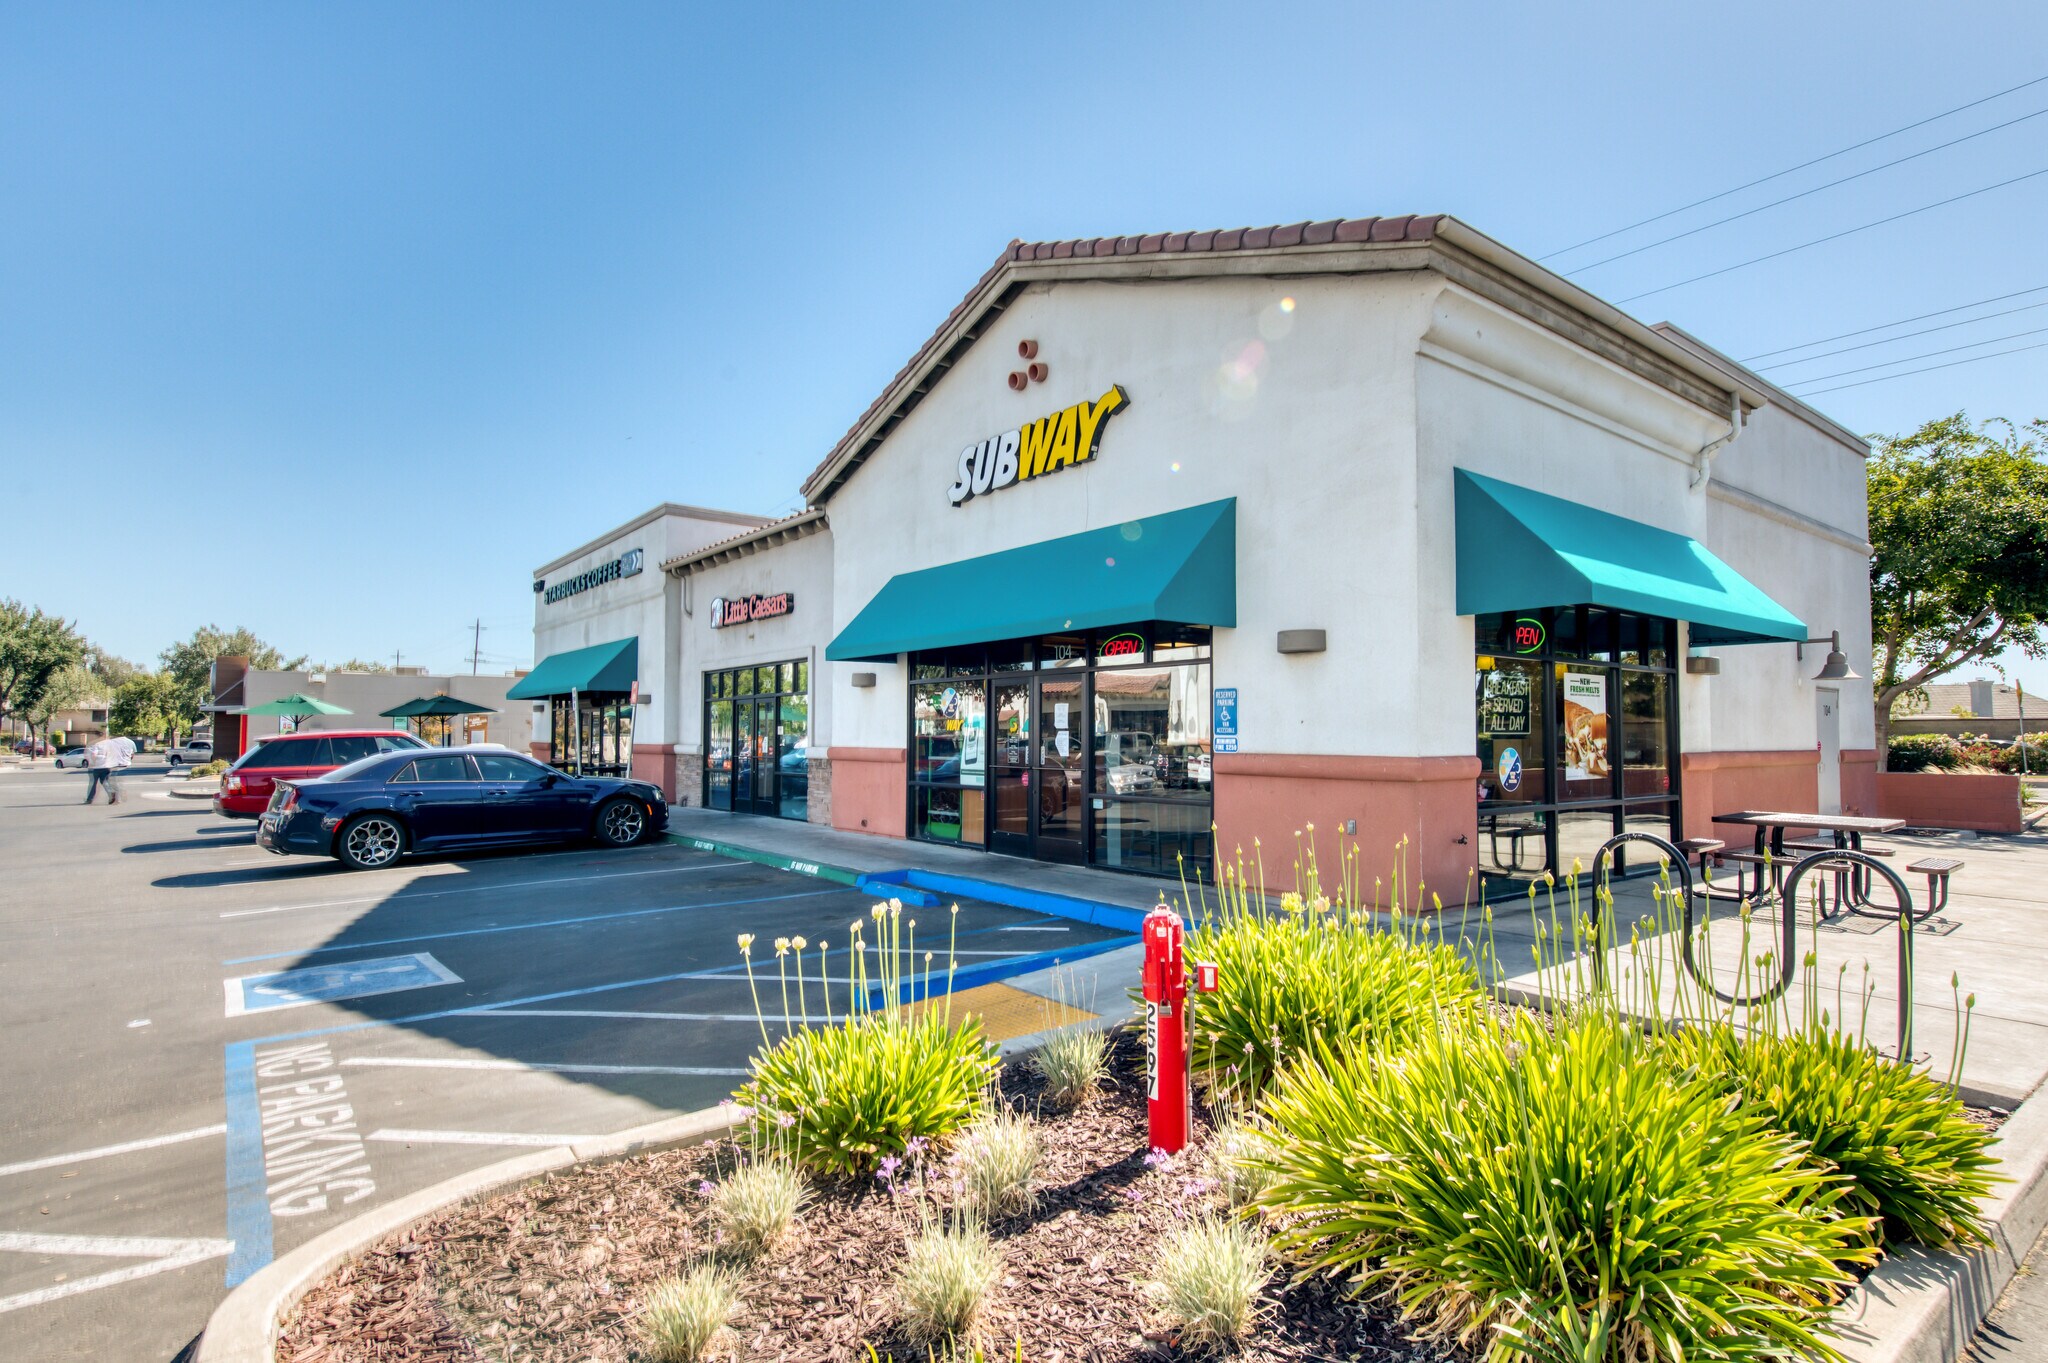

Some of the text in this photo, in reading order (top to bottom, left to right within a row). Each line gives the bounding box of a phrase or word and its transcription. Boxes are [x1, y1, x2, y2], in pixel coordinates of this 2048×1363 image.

[947, 384, 1124, 503] SUBWAY
[543, 575, 586, 606] STARBUCKS
[586, 560, 621, 590] COFFEE
[724, 593, 788, 626] Little Caesars
[1516, 626, 1540, 646] PEN
[1054, 644, 1072, 661] 104
[1104, 639, 1139, 657] OPEN
[1487, 679, 1529, 696] BREAKFAST
[1570, 685, 1584, 693] FRESH
[1493, 697, 1524, 713] SERVED
[1491, 715, 1526, 731] ALL DAY
[255, 1042, 376, 1216] NO PARKING
